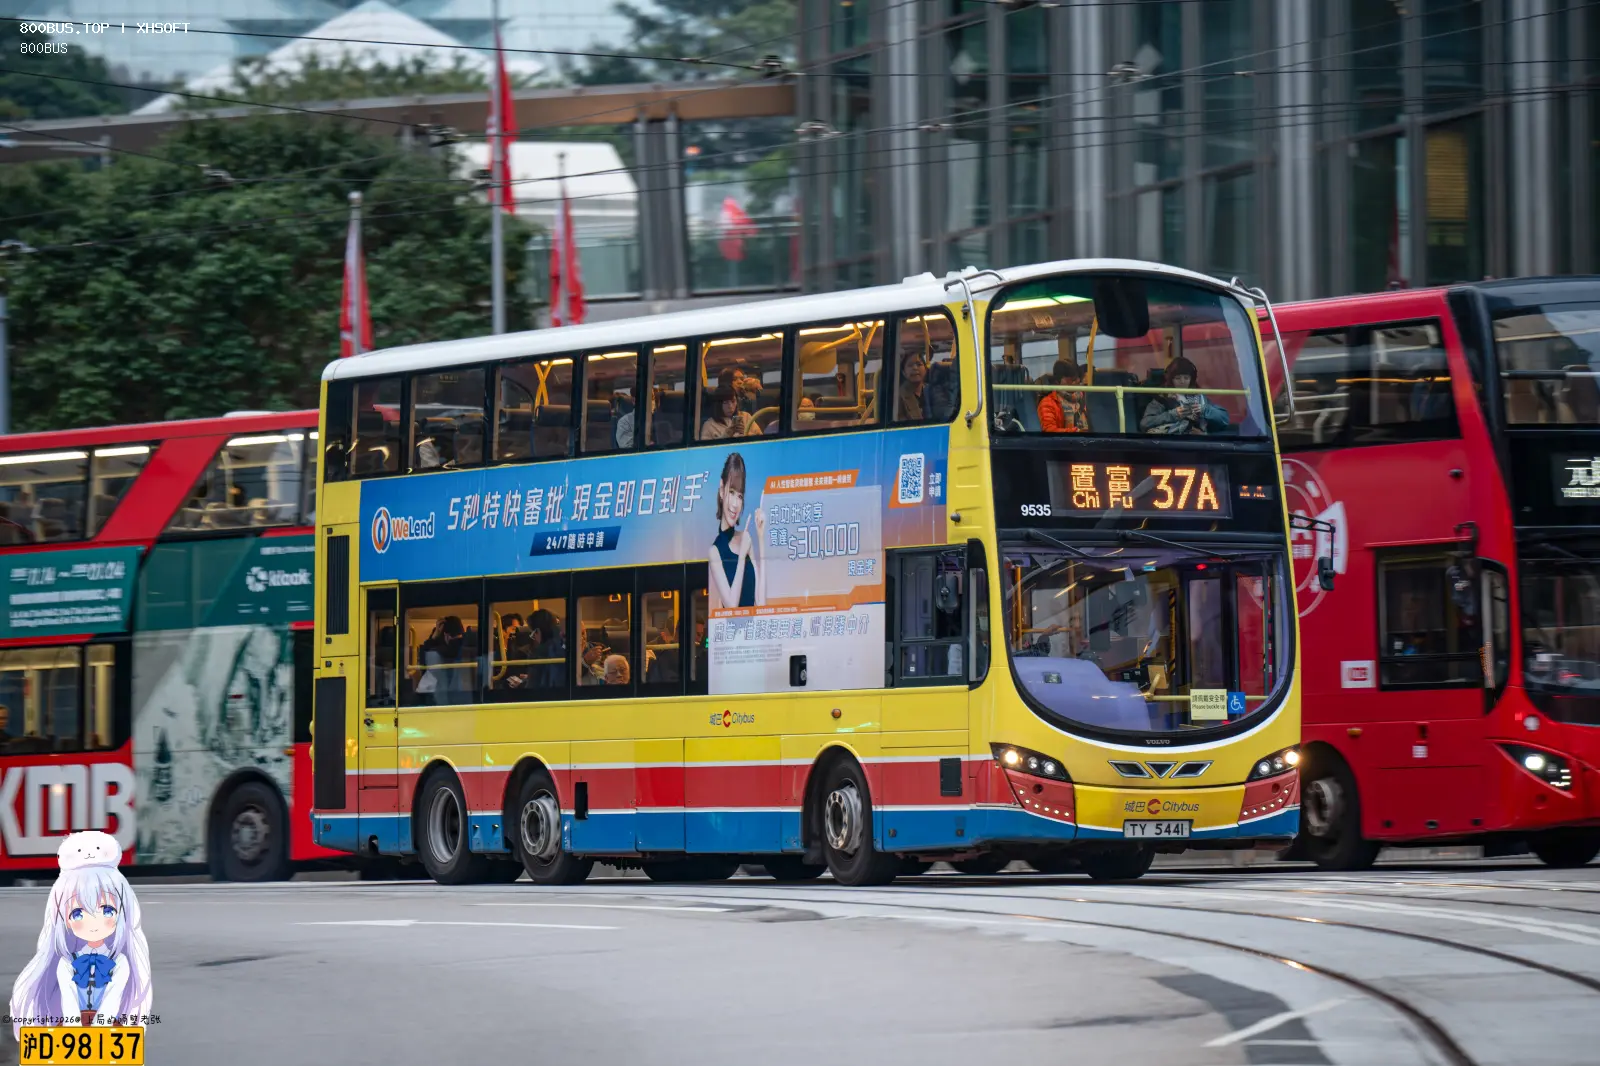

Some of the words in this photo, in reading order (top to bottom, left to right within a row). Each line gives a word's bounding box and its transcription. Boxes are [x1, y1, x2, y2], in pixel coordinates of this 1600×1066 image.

[1150, 468, 1219, 510] 37A
[1072, 491, 1100, 508] Chi
[1109, 491, 1133, 508] Fu
[1020, 503, 1051, 517] 9535
[392, 512, 435, 541] WeLend
[732, 712, 755, 725] Citybus
[1124, 800, 1146, 812] 城巴
[1162, 800, 1200, 812] Citybus
[1130, 823, 1147, 836] TY
[1154, 823, 1184, 836] 5441
